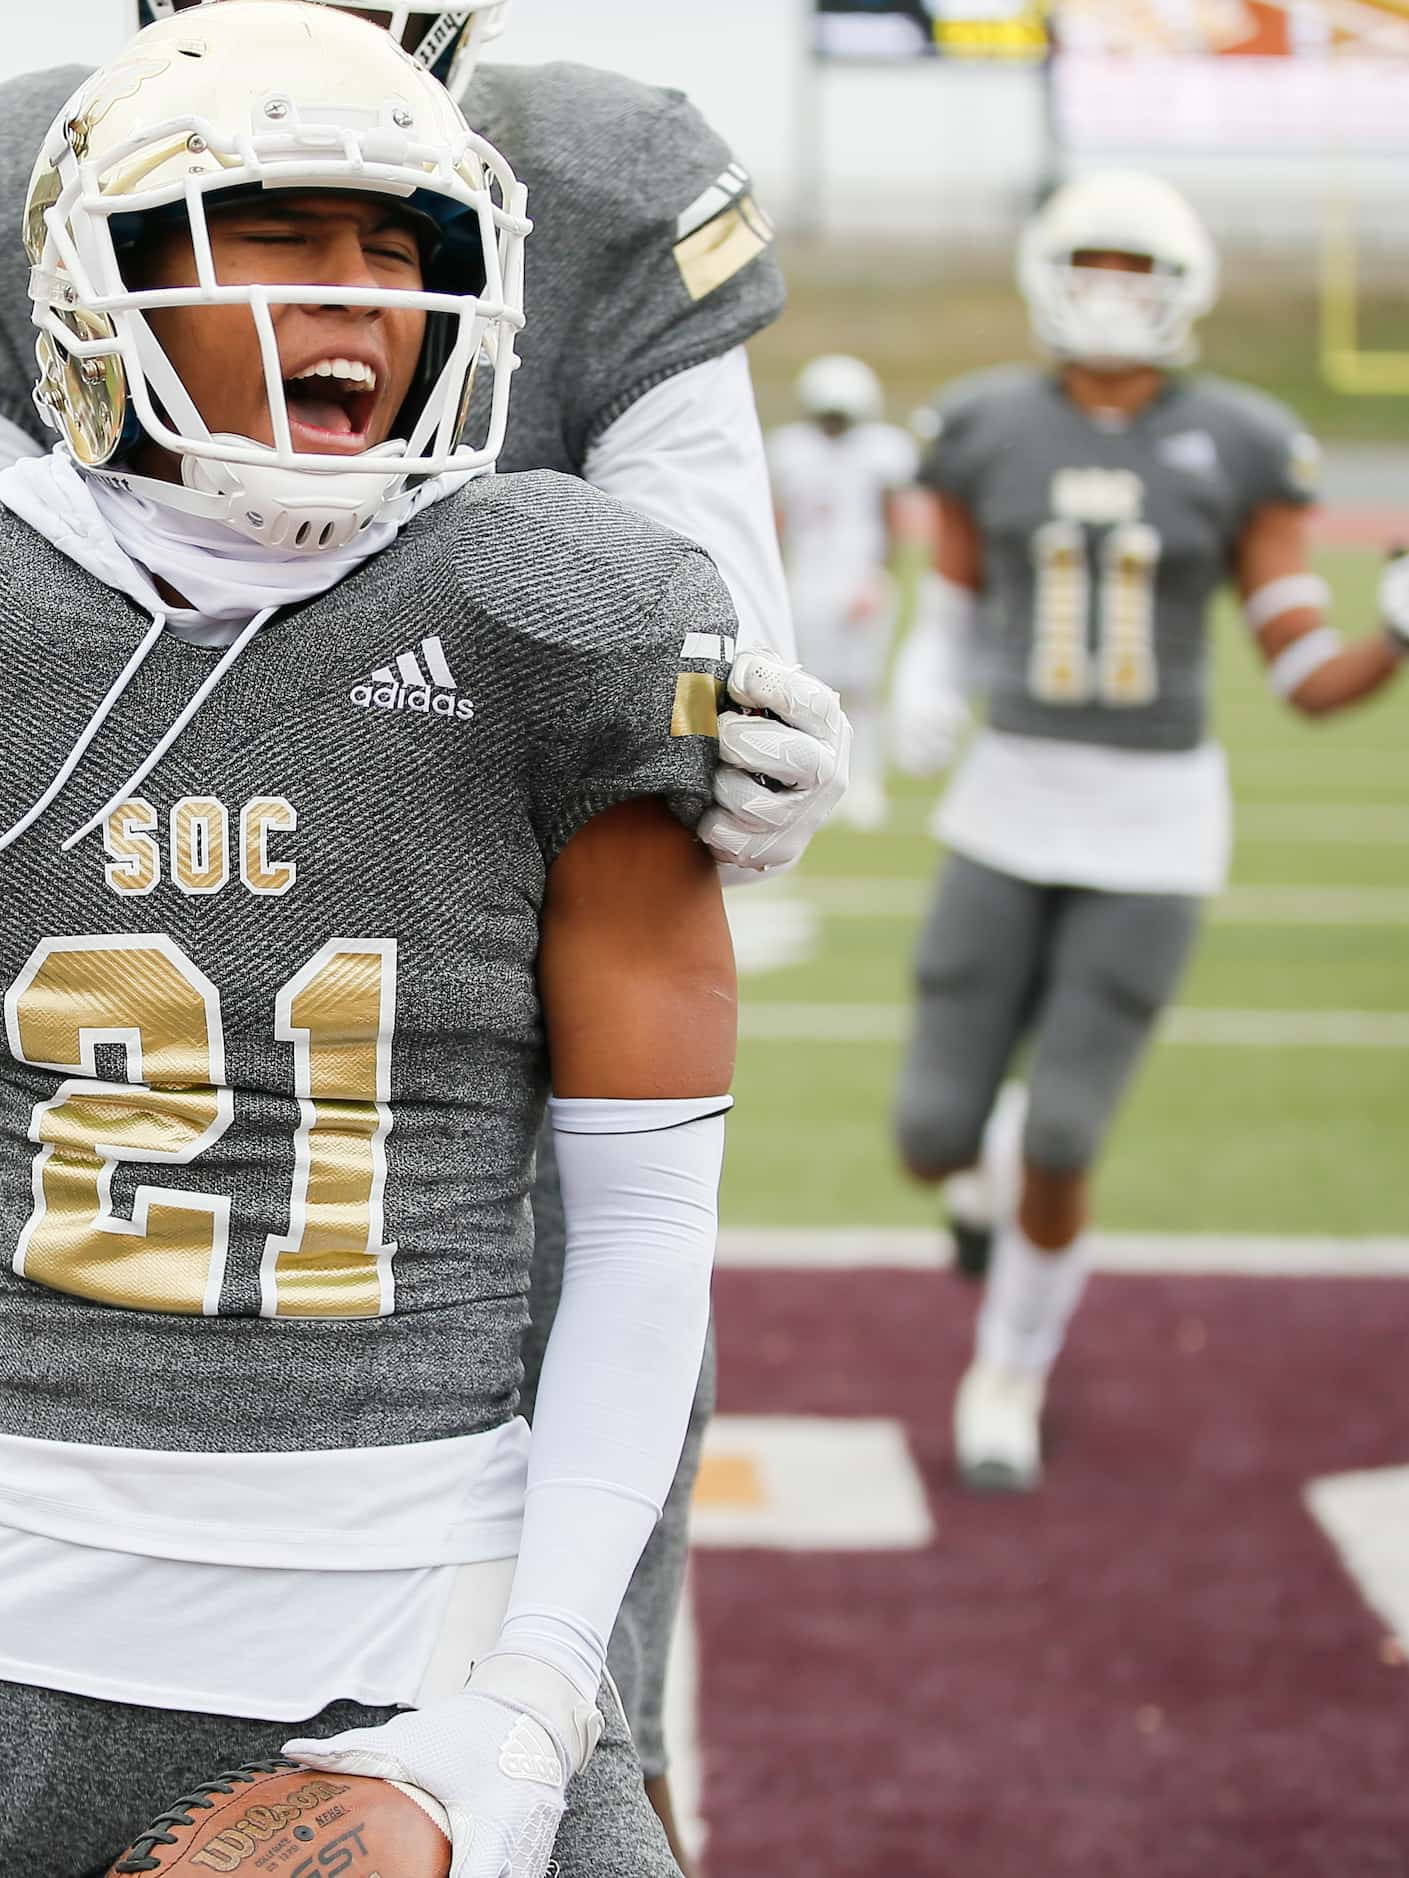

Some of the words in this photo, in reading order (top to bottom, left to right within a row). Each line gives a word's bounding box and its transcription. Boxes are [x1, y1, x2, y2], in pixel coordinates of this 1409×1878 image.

[1028, 520, 1161, 708] 11
[350, 680, 475, 721] adidas
[103, 796, 298, 896] SOC
[5, 933, 399, 1320] 21
[189, 1780, 351, 1873] Wilson
